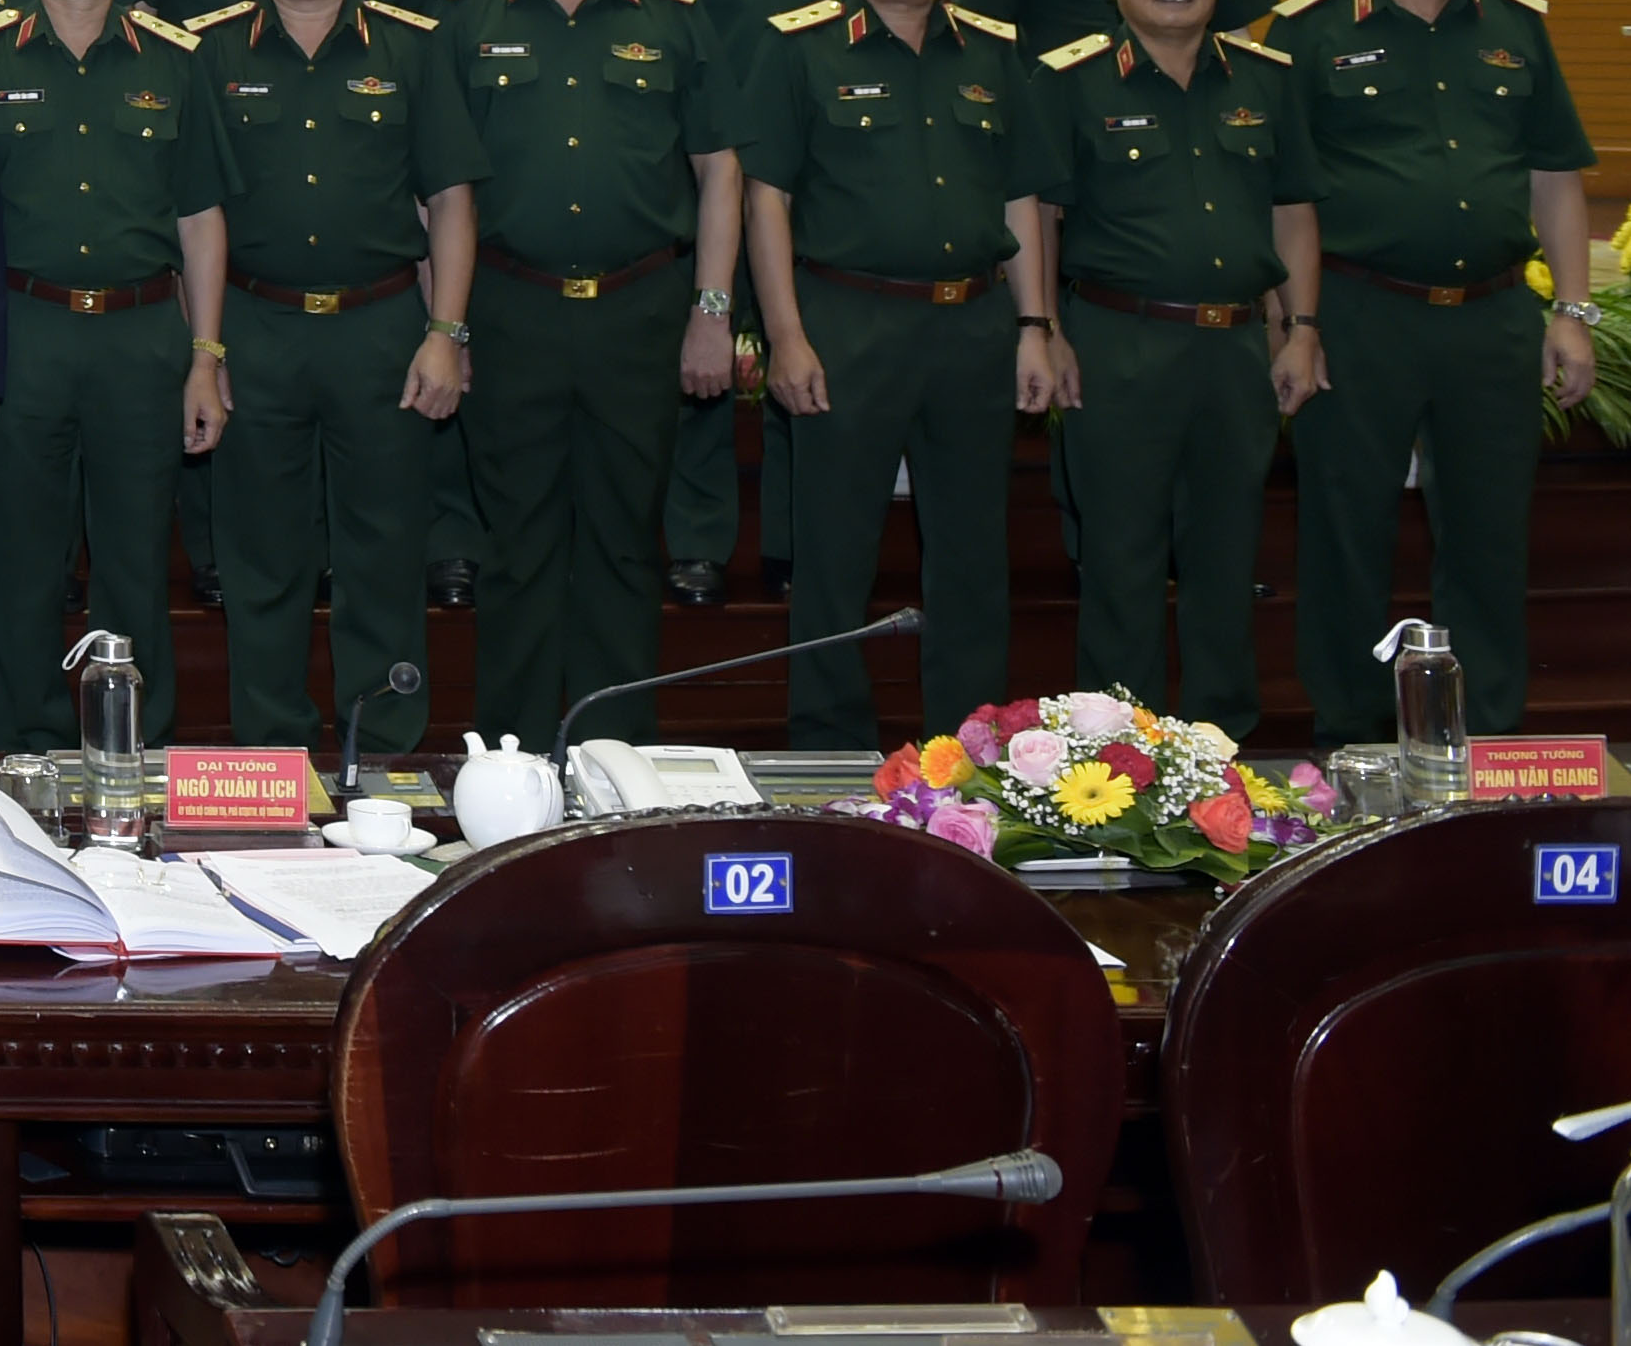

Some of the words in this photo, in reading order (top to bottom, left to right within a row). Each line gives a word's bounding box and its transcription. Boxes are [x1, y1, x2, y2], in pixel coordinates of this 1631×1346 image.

[197, 760, 222, 774] ĐẠI
[226, 759, 277, 772] TƯỚNG
[1475, 769, 1516, 788] PHAN
[1518, 766, 1549, 787] VĂN
[1552, 767, 1598, 787] GIANG
[176, 775, 210, 797] NGÔ
[214, 775, 258, 798] XUÂN
[261, 779, 297, 802] LỊCH
[726, 864, 775, 904] 02
[1554, 855, 1599, 892] 04
